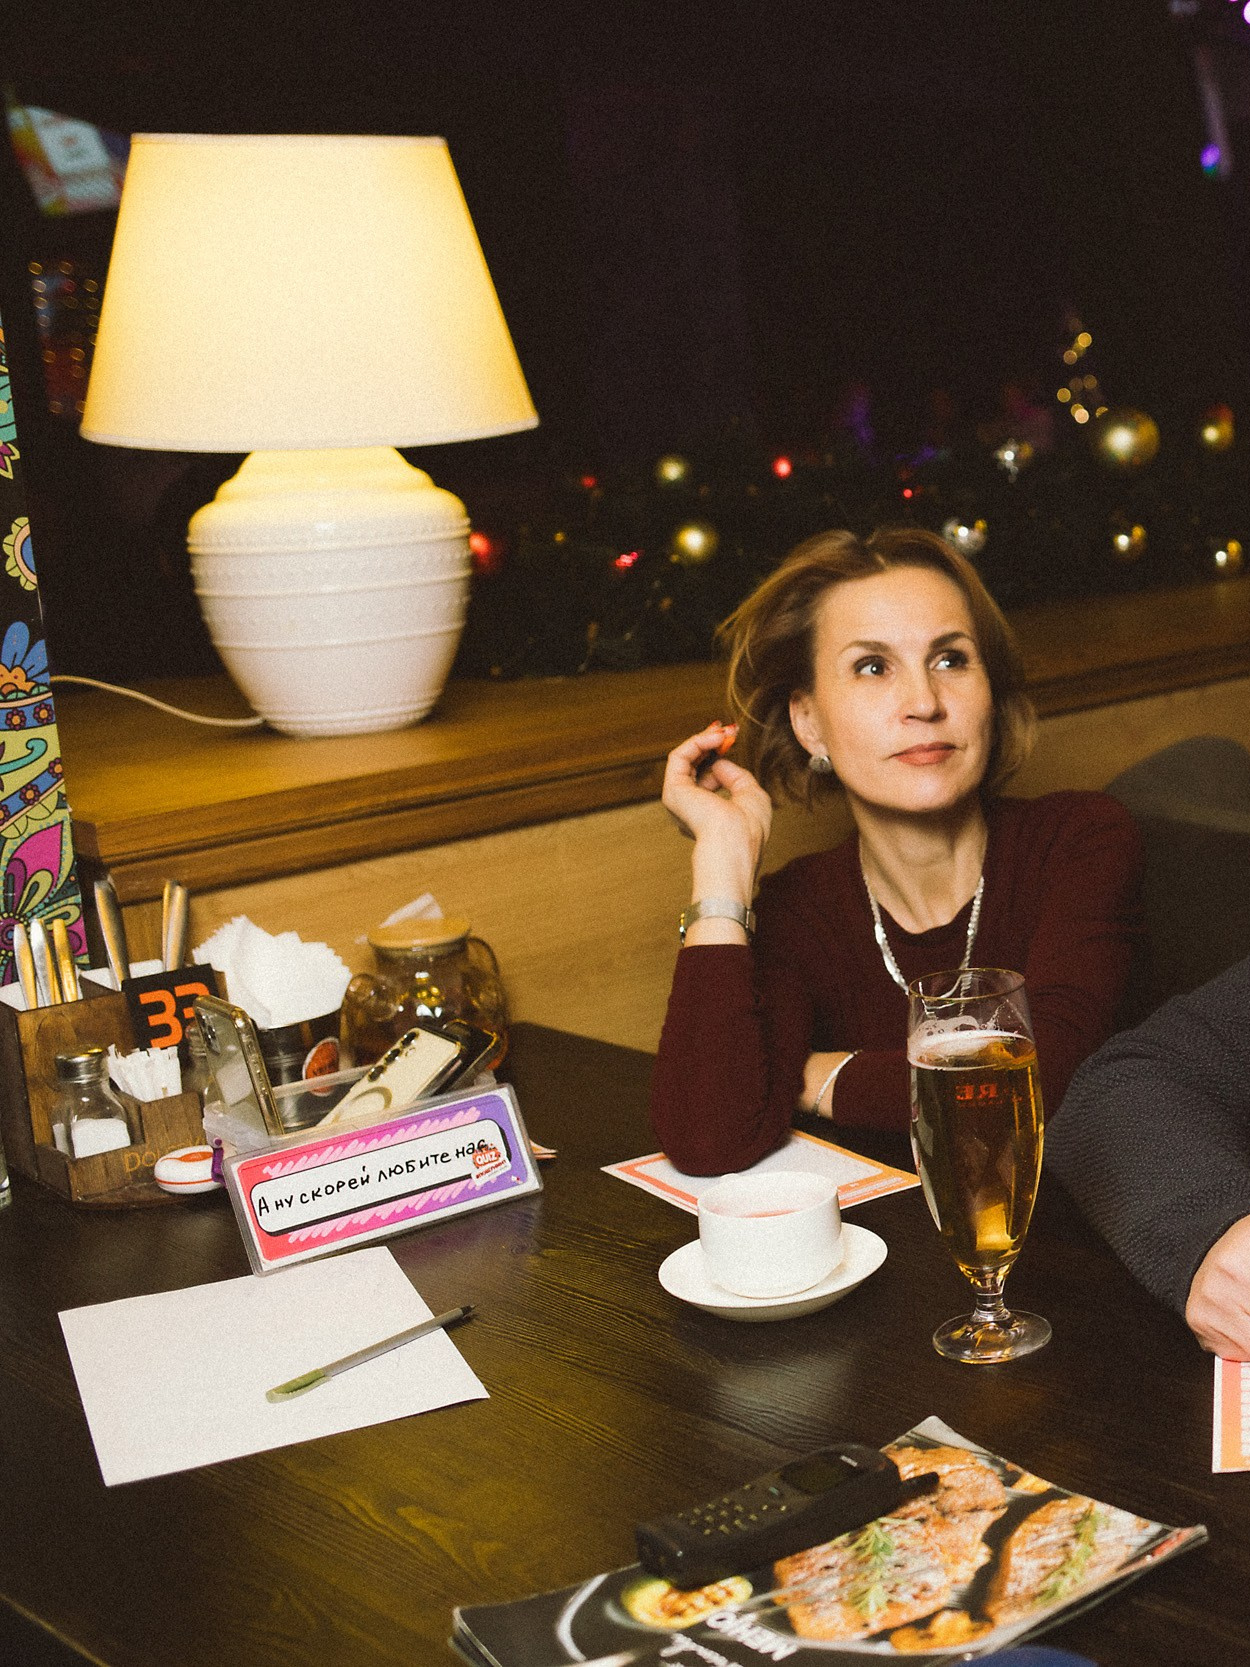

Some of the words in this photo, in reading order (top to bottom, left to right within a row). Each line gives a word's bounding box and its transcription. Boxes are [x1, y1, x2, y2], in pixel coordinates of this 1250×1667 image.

[475, 1150, 498, 1165] QUIZ
[257, 1196, 270, 1217] А
[274, 1193, 294, 1212] ну
[299, 1166, 370, 1204] скорей
